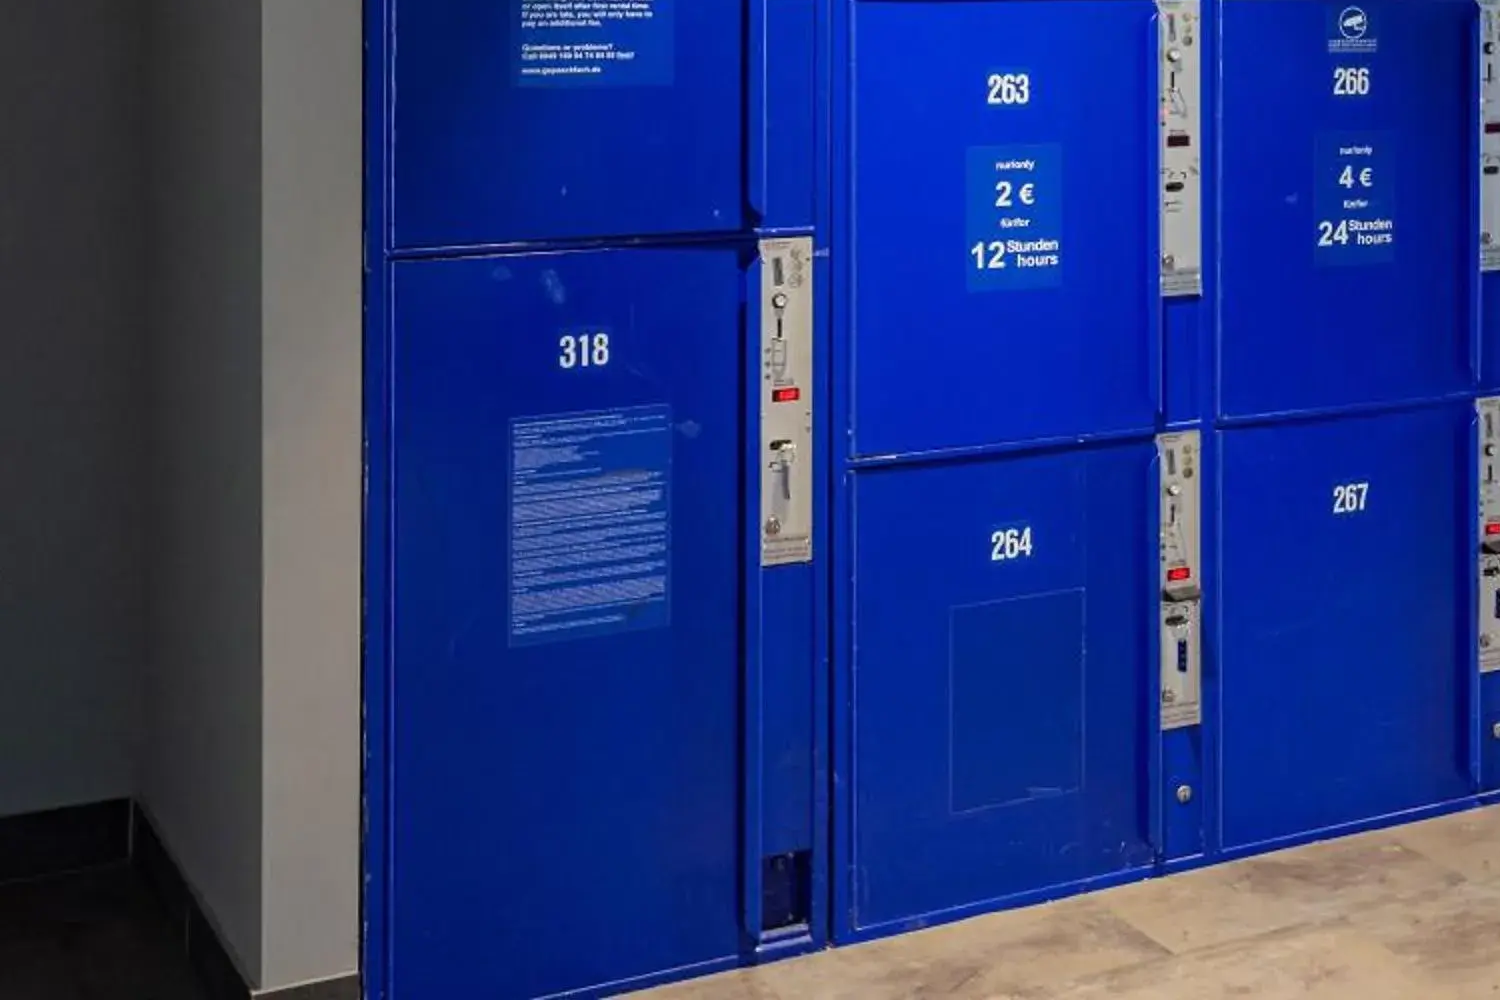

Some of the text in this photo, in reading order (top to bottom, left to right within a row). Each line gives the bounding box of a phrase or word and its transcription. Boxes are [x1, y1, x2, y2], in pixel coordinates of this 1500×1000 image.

[987, 74, 1030, 104] 263
[1333, 67, 1369, 95] 266
[1339, 165, 1373, 189] 4 €
[995, 181, 1035, 207] 2 €
[1318, 218, 1393, 246] 24 Stunden
[1357, 232, 1393, 245] hours
[971, 239, 1059, 269] 12 Stunden
[1017, 253, 1059, 268] hours
[559, 333, 609, 369] 318
[1333, 483, 1369, 514] 267
[991, 527, 1033, 562] 264
